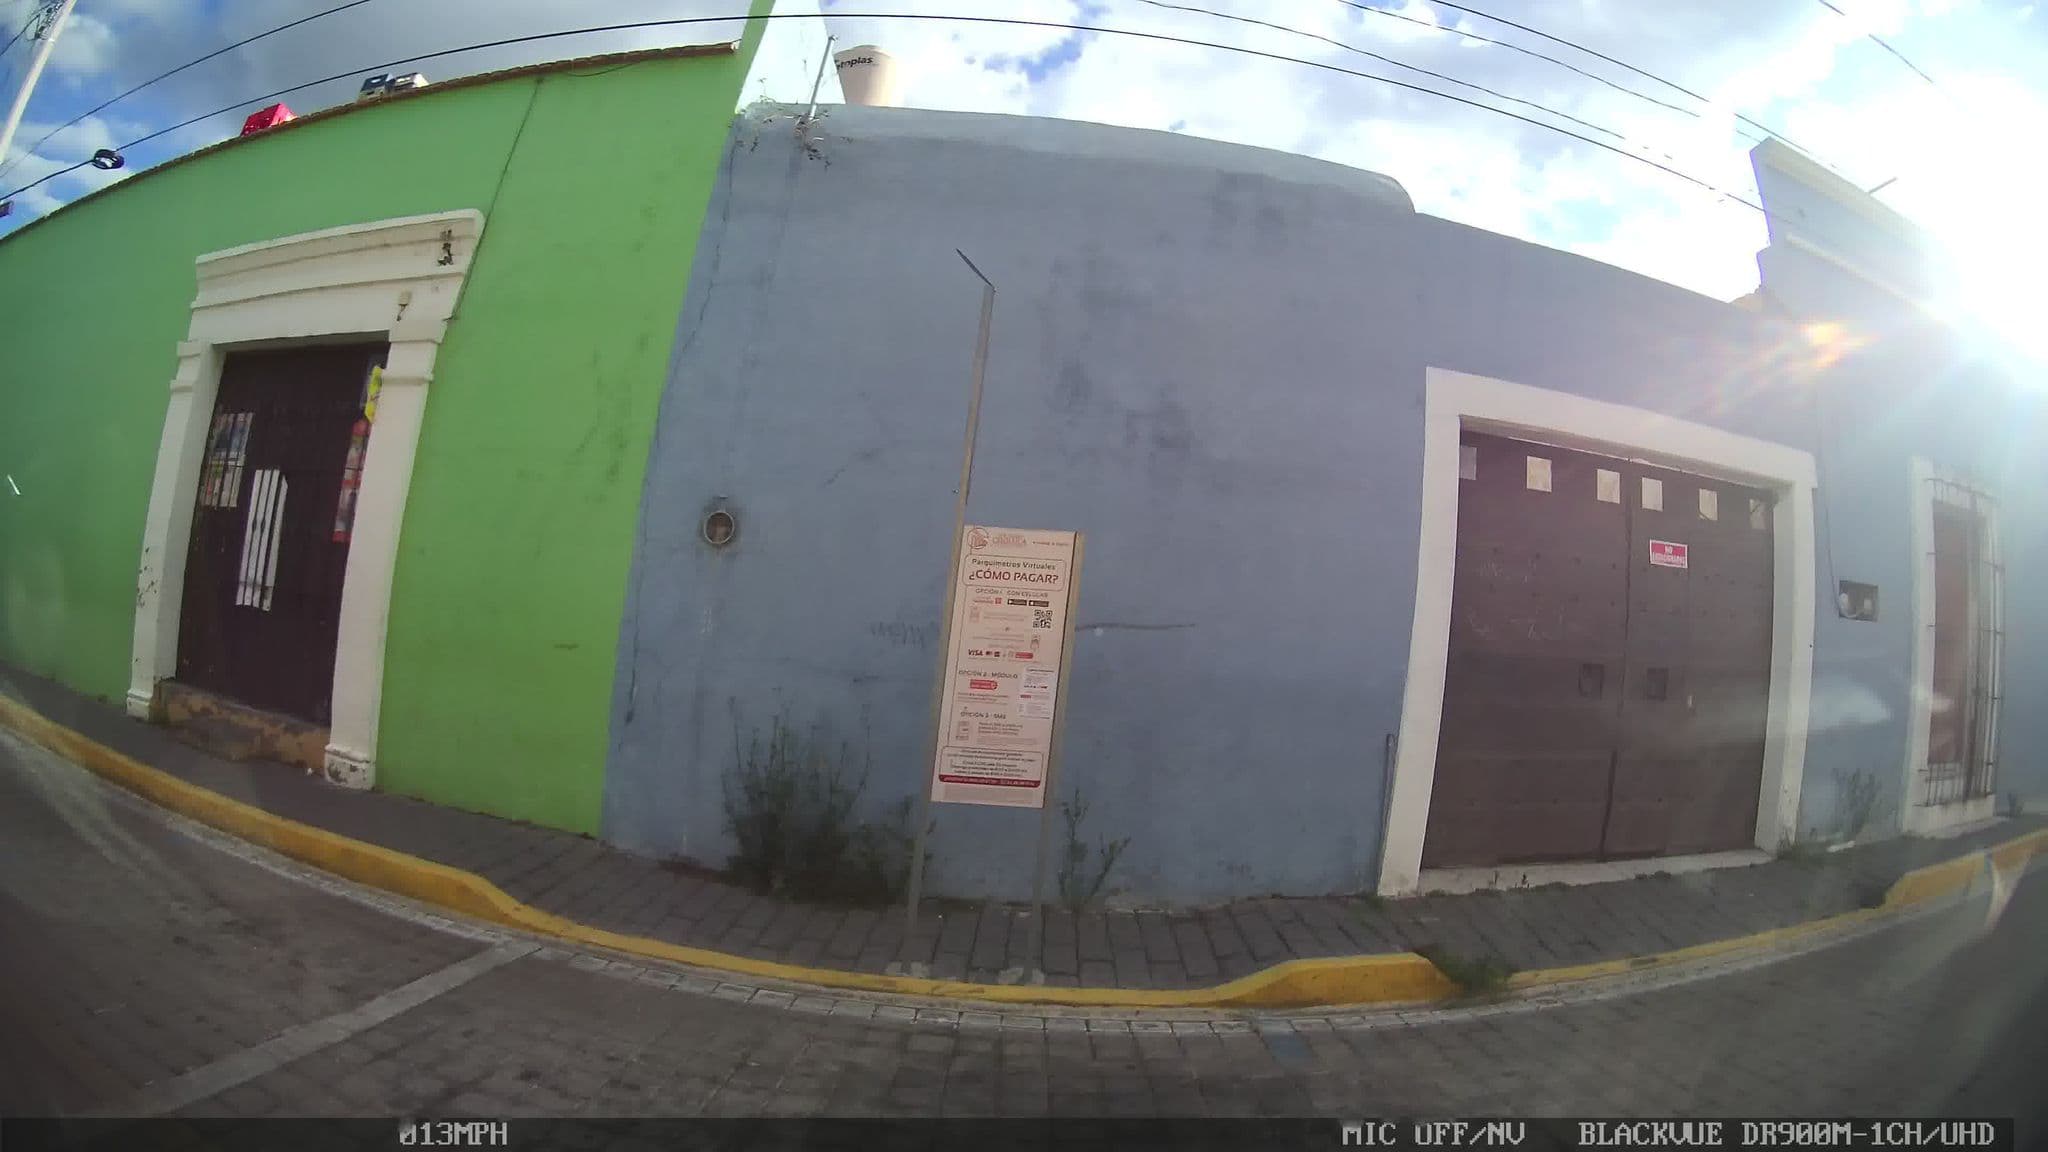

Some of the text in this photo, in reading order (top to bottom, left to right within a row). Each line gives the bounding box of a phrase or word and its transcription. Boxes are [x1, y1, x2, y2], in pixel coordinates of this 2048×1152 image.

[1023, 561, 1056, 570] Virtuales
[968, 568, 1059, 584] ¿CÓMO PAGAR?
